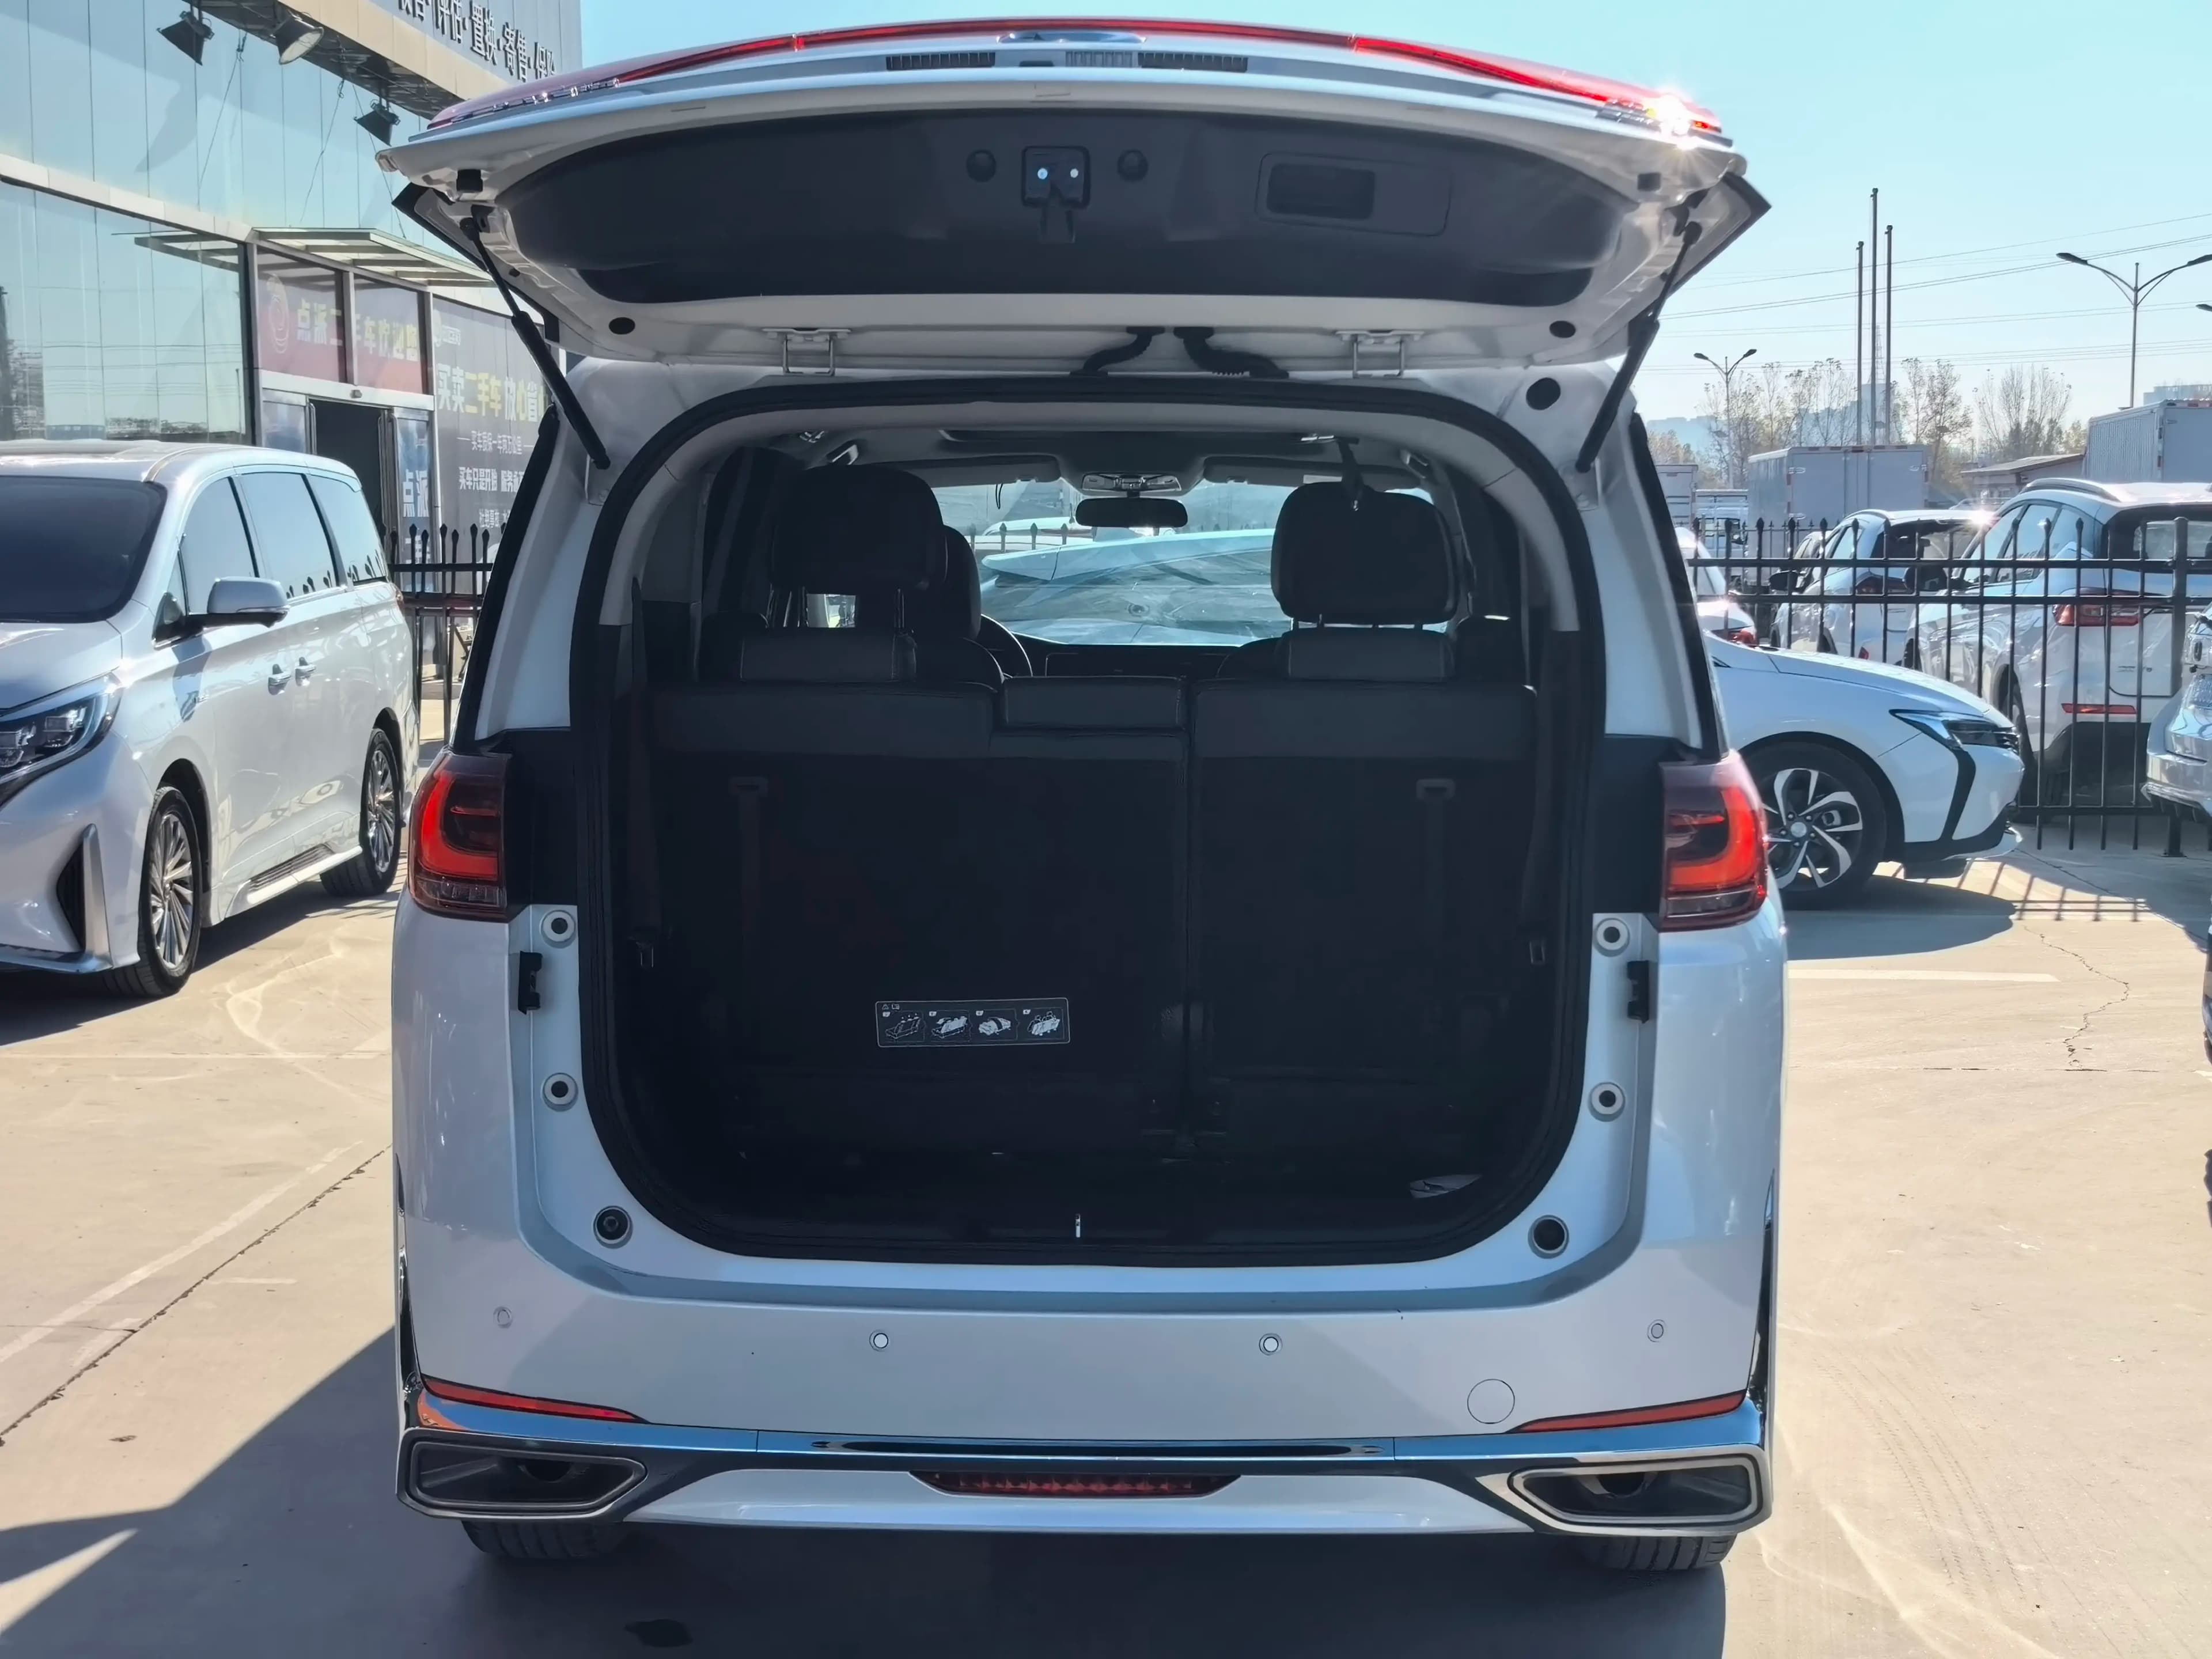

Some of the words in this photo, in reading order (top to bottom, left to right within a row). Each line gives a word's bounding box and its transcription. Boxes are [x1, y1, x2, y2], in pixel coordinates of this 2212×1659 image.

[403, 468, 429, 517] 点派
[459, 467, 498, 491] 买车只是开始
